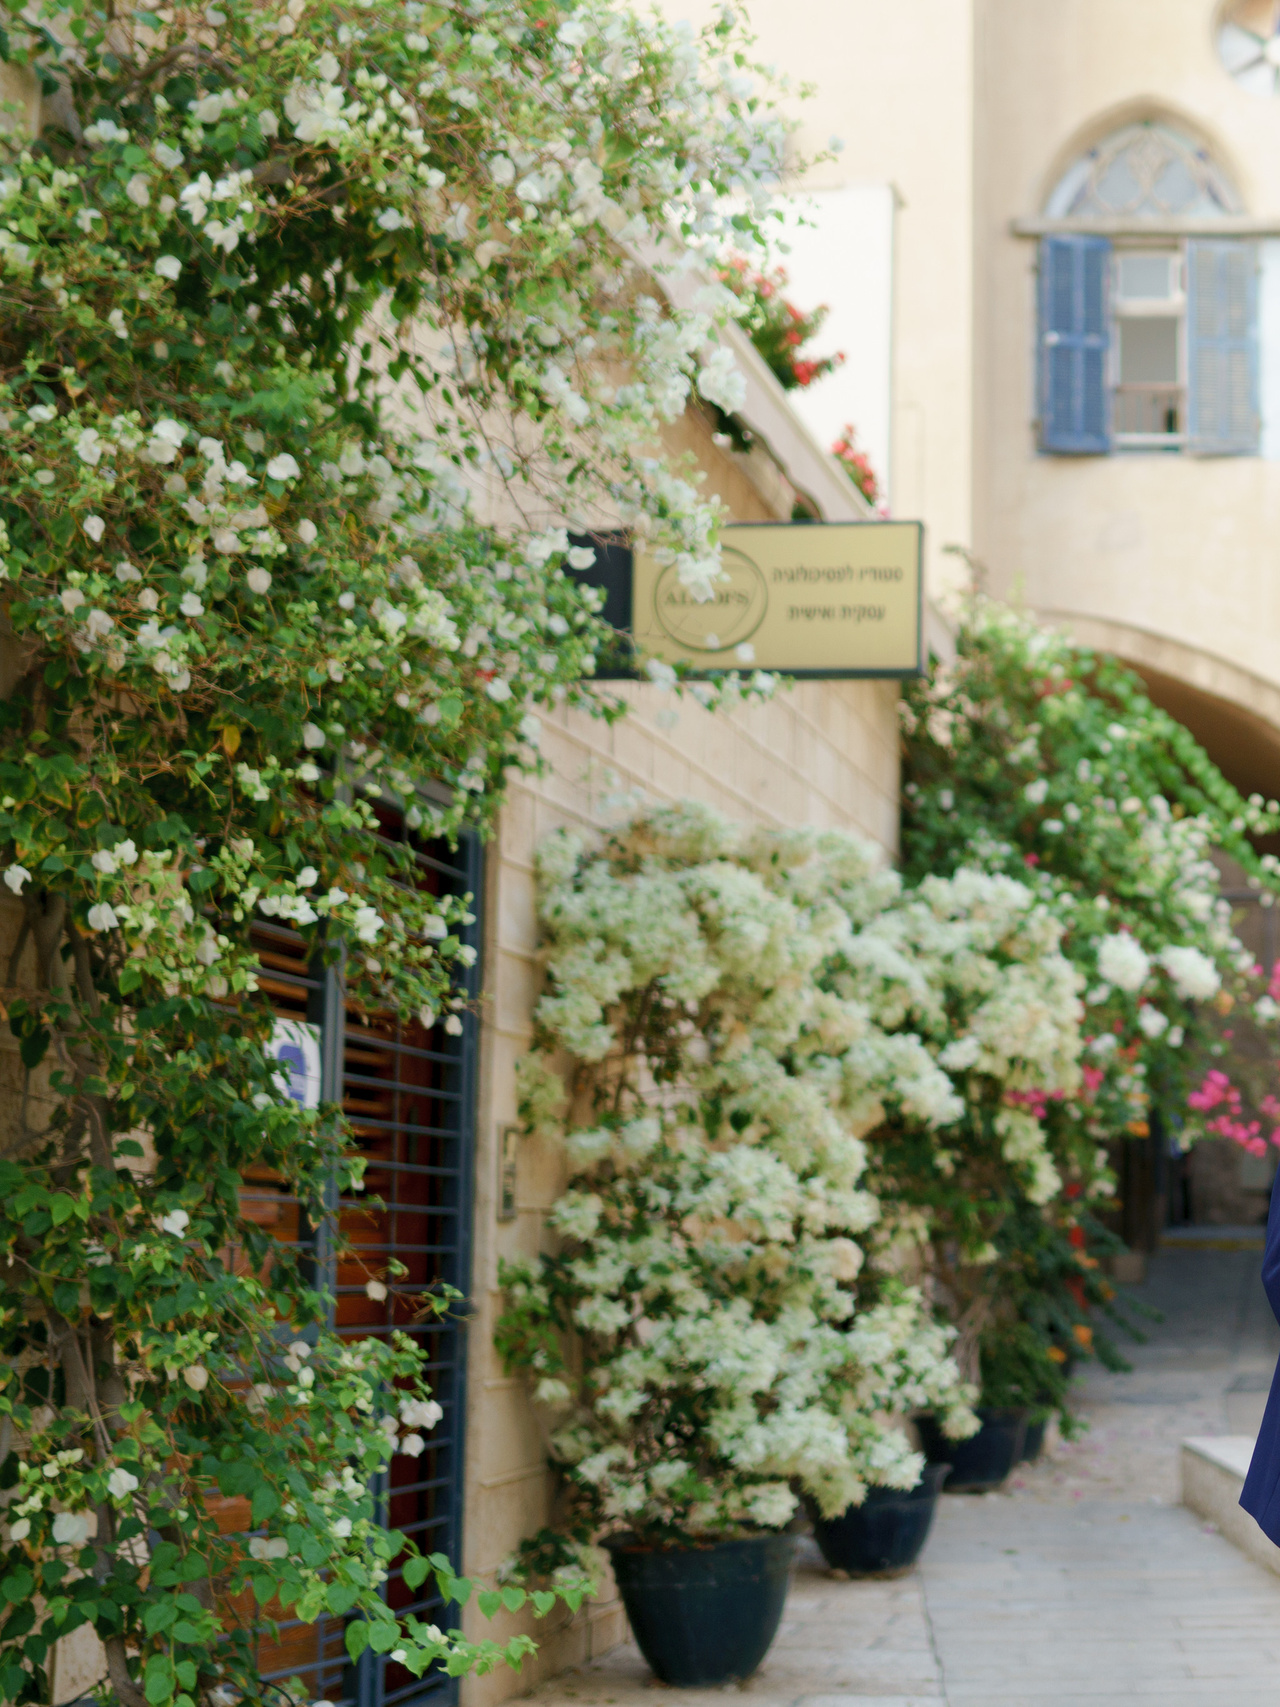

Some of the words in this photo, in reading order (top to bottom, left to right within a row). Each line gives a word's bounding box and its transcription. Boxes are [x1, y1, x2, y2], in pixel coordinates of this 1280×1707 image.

[772, 561, 854, 583] לפסיכולוגיה
[859, 566, 904, 582] סטודיו
[787, 605, 836, 620] ואישית
[841, 605, 886, 622] עסקית
